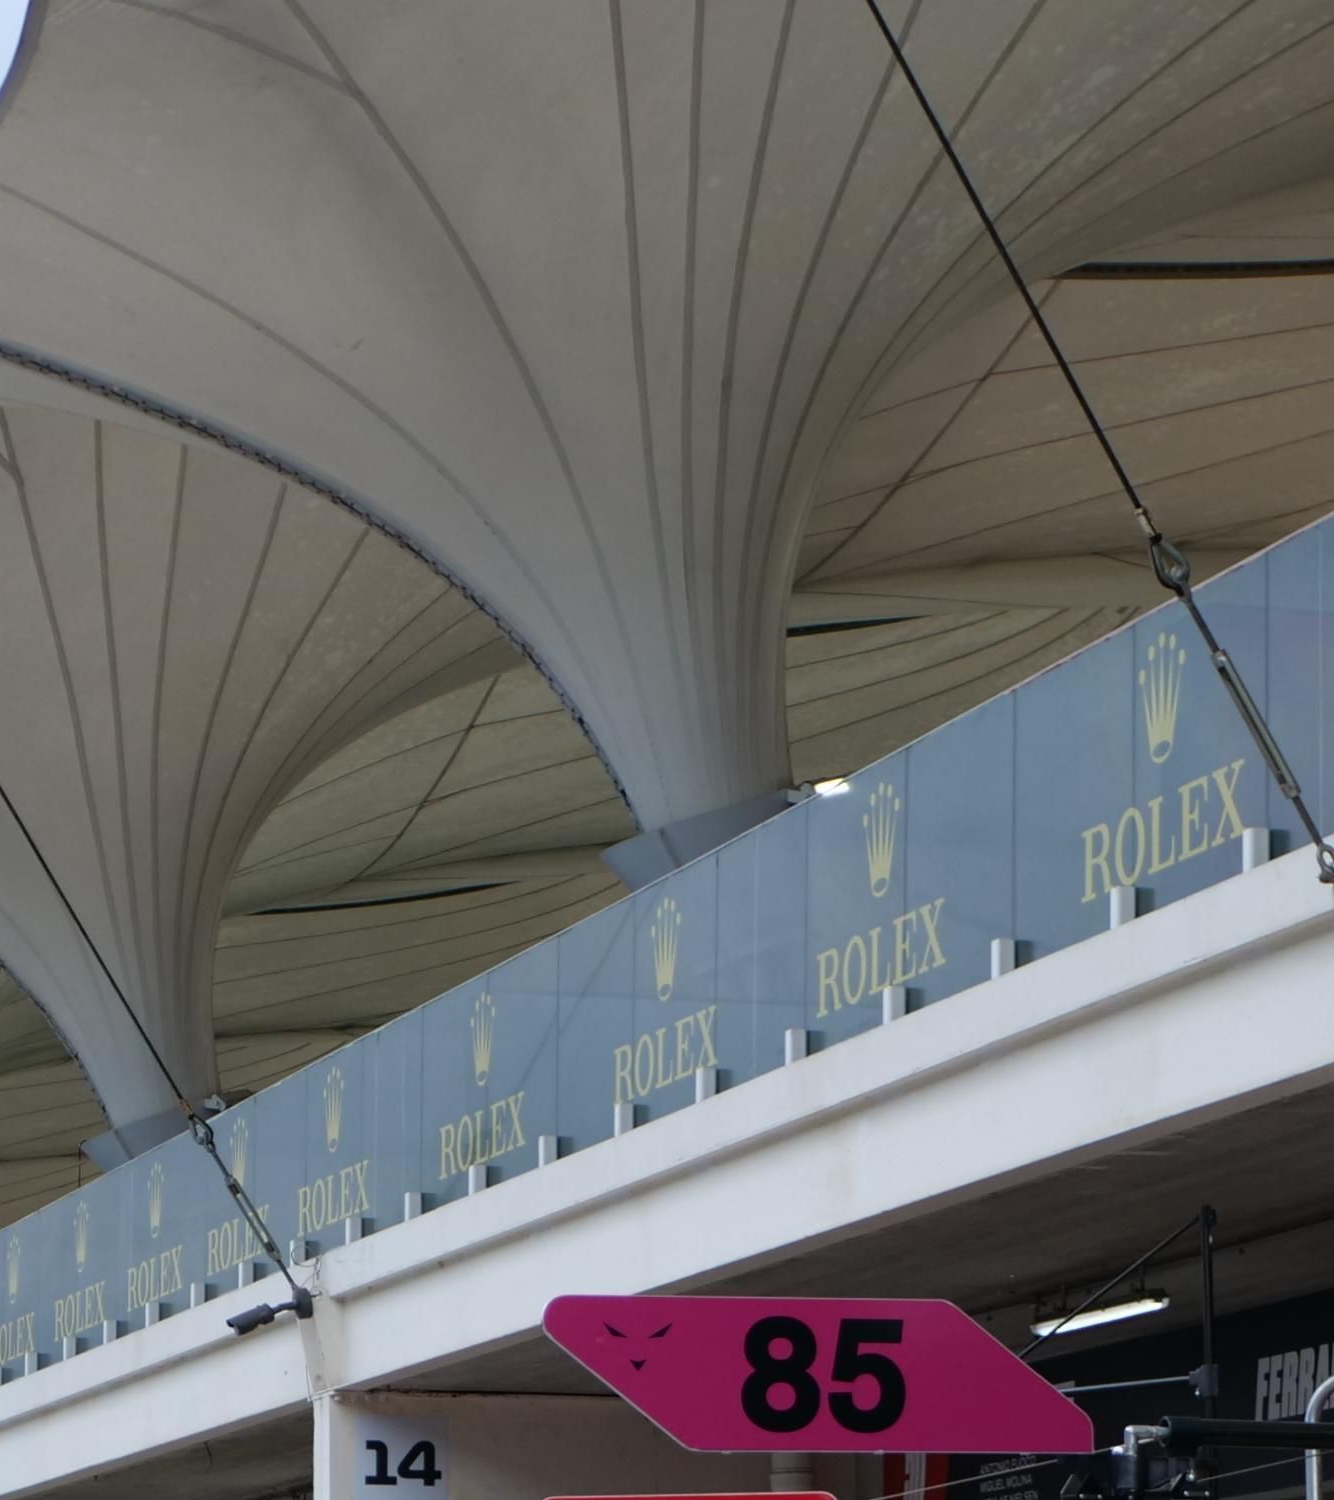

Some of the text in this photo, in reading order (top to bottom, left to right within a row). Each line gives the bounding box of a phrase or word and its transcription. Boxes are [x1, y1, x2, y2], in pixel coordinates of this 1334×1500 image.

[1080, 759, 1245, 903] ROLEX
[816, 898, 946, 1018] ROLEX
[613, 1005, 719, 1104] ROLEX
[439, 1092, 526, 1181] ROLEX
[207, 1204, 269, 1276] ROLEX
[297, 1160, 369, 1238] ROLEX
[54, 1281, 105, 1342] ROLEX
[127, 1245, 183, 1312] ROLEX
[740, 1314, 907, 1434] 85
[365, 1440, 442, 1487] 14
